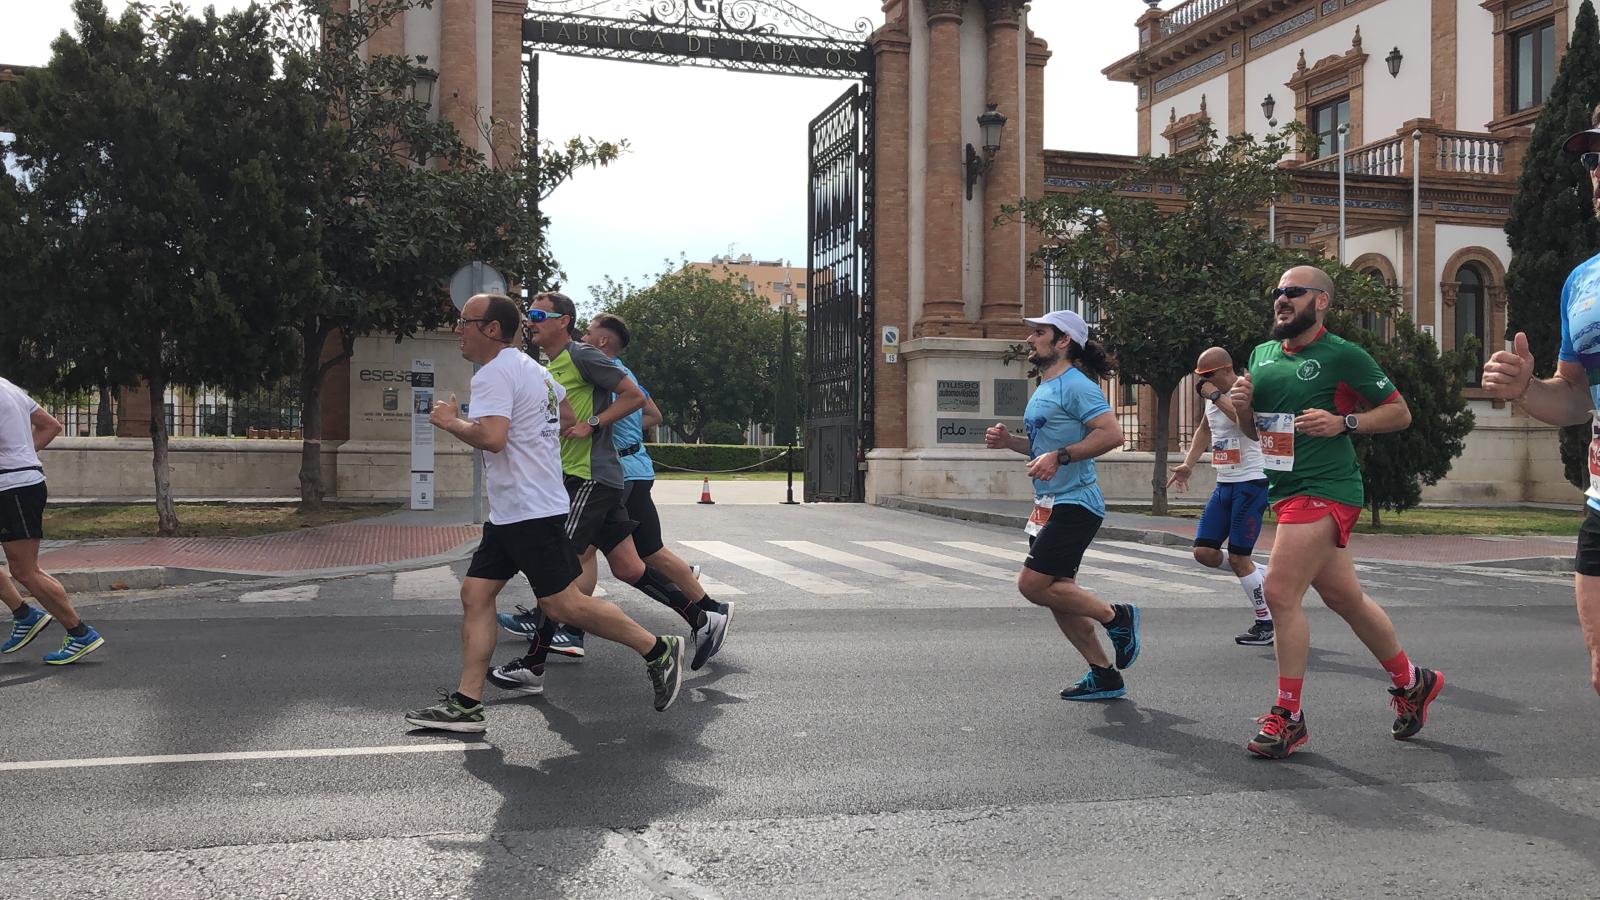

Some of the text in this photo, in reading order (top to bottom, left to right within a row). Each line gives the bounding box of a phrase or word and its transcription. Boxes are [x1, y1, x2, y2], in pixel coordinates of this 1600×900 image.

[540, 22, 858, 67] FABRICA DE TABACOS
[938, 381, 979, 389] museo
